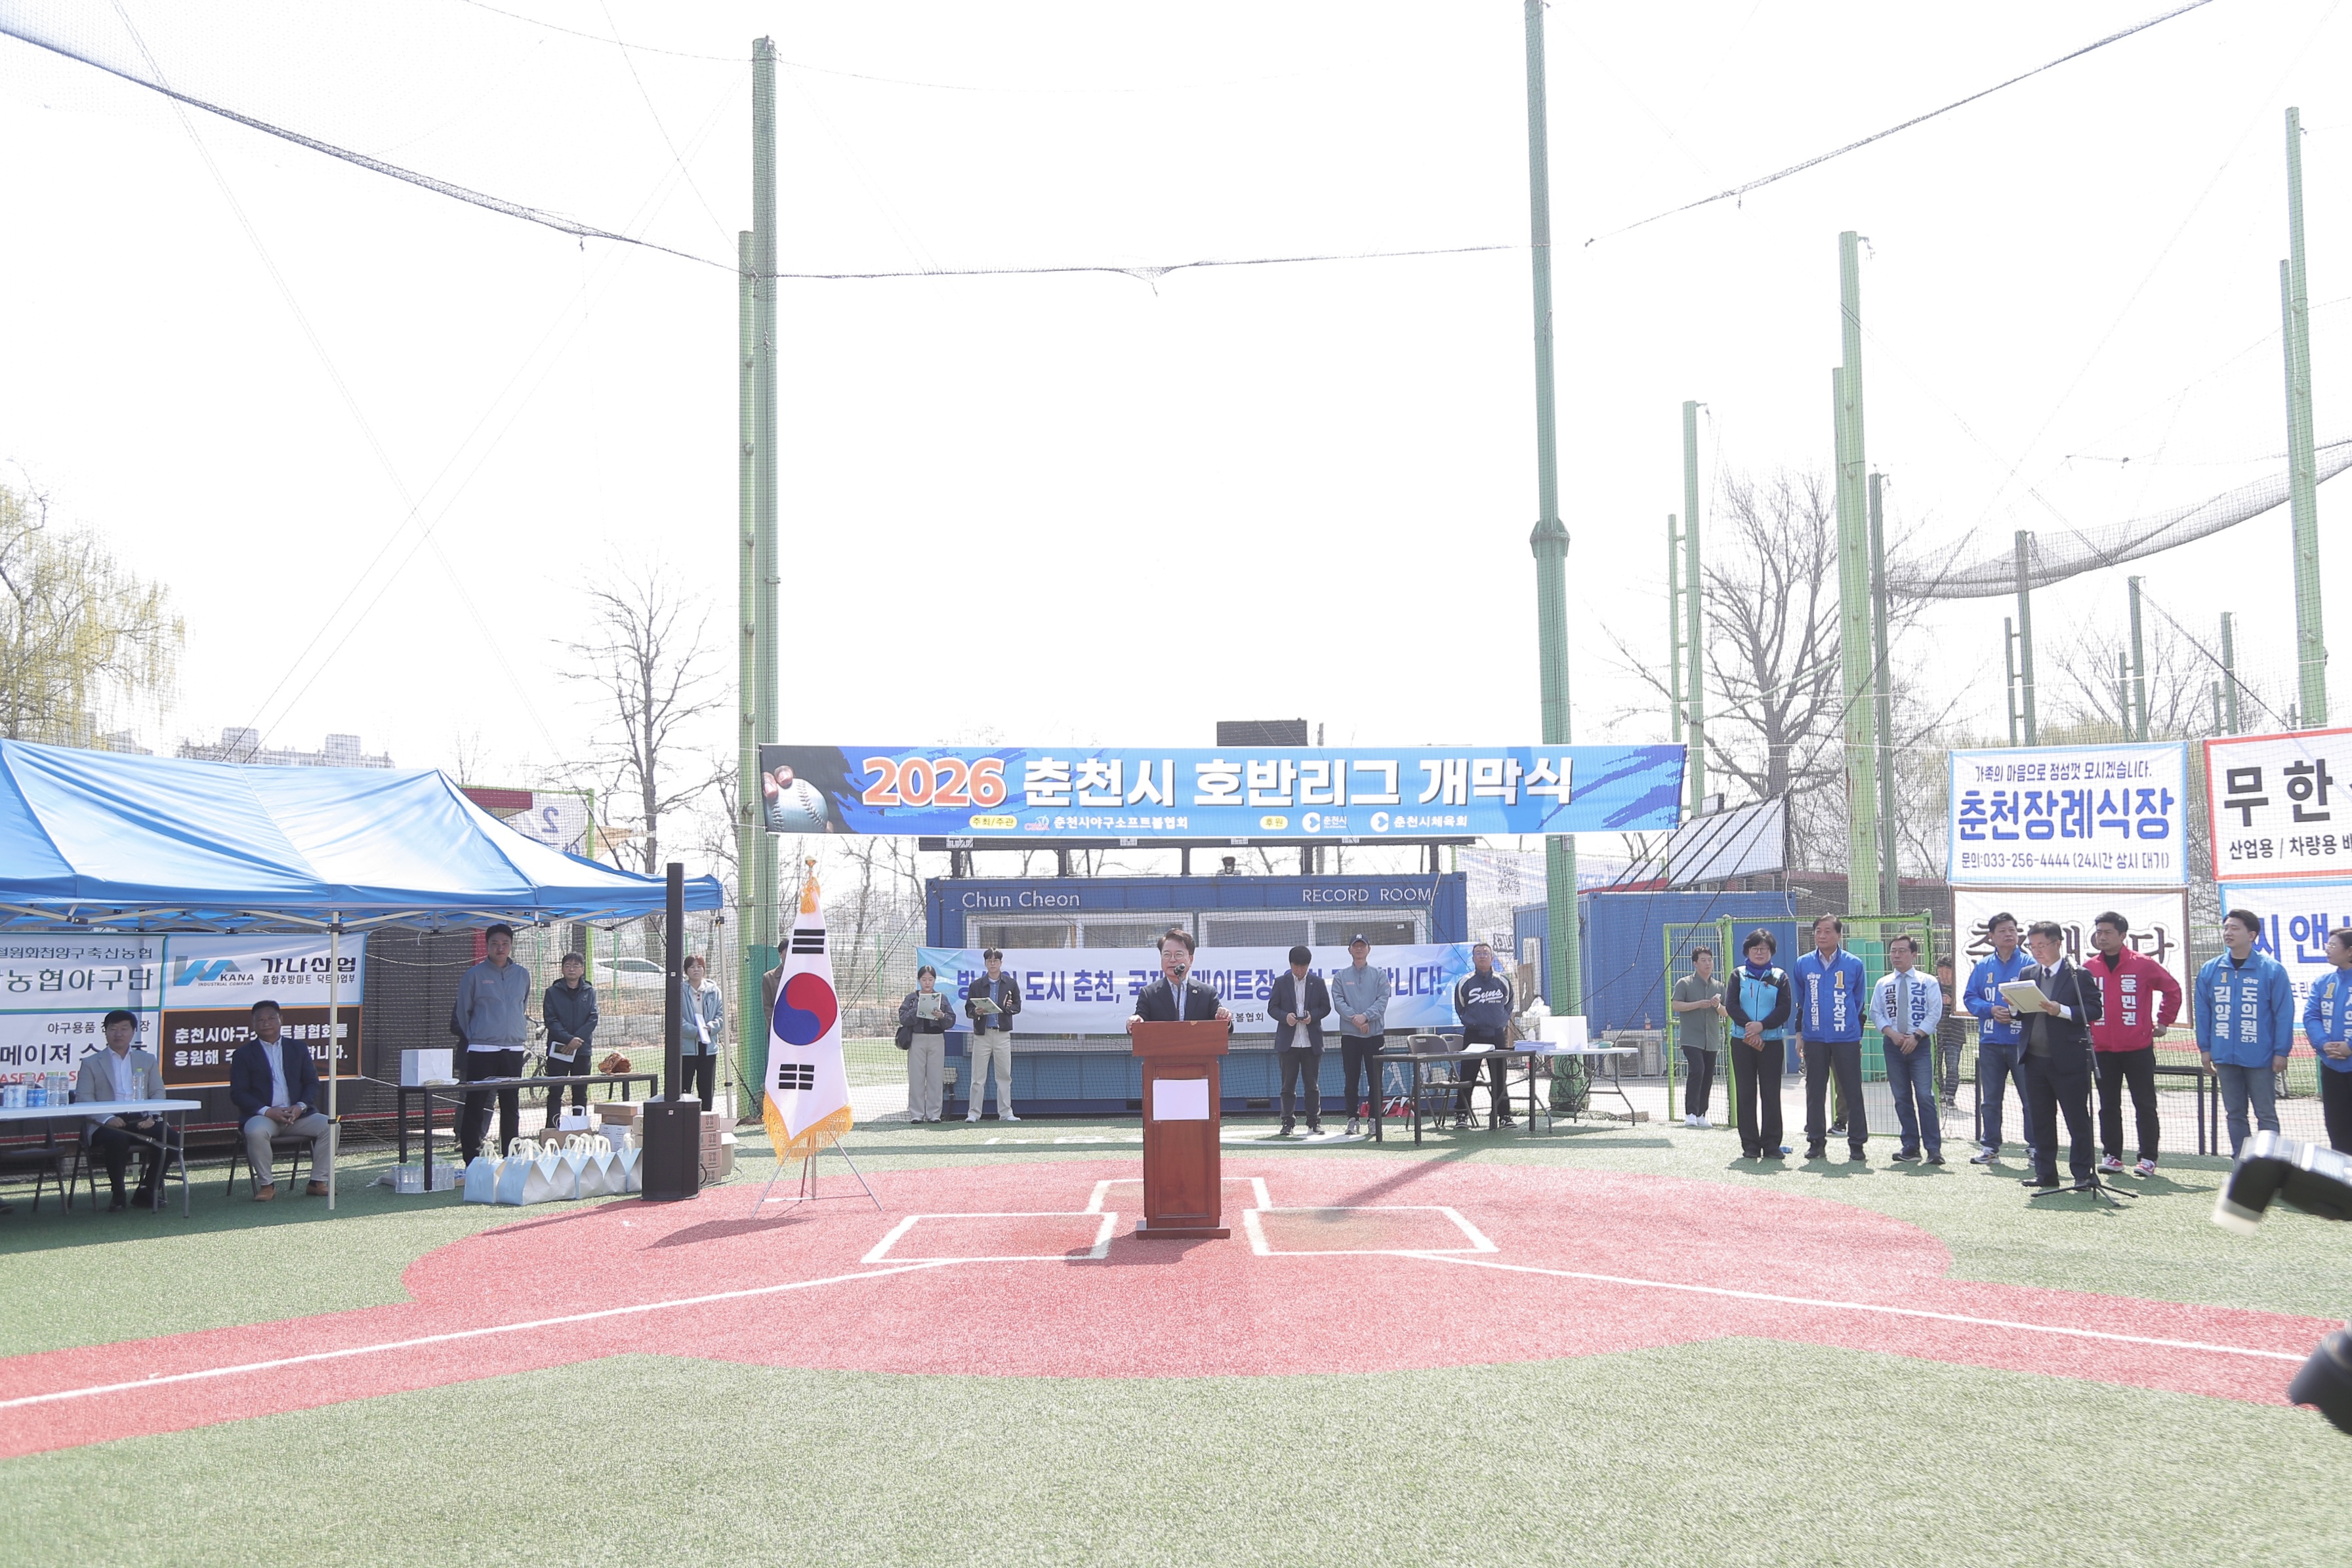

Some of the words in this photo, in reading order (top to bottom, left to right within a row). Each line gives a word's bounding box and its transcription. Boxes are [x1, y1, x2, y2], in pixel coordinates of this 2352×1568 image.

[1975, 766, 2004, 782] 가족의
[2007, 764, 2046, 781] 마음으로
[2050, 762, 2080, 781] 정성껏
[2084, 760, 2152, 780] 모시겠습니다.
[862, 756, 1007, 808] 2026
[1023, 758, 1176, 807] 춘천시
[1194, 758, 1401, 807] 호반리그
[1418, 756, 1573, 806] 개막식
[2224, 758, 2352, 827] 무한
[972, 817, 1014, 827] 주최/주관
[1054, 815, 1189, 829] 춘천시야구소프트볼협회
[1266, 817, 1284, 827] 후원
[1323, 815, 1347, 825] 춘천시
[1393, 815, 1468, 828] 춘천시체육회
[1958, 787, 2174, 840] 춘천장례식장
[2229, 838, 2273, 859] 산업용
[2290, 835, 2337, 856] 차량용
[1962, 853, 2070, 869] 문의:033-256-4444
[2073, 853, 2113, 869] (24시간
[2116, 853, 2139, 869] 상시
[2142, 852, 2169, 868] 대기)
[961, 892, 1011, 909] Chun
[1018, 890, 1081, 908] Cheon
[1302, 888, 1370, 903] RECORD
[1380, 887, 1432, 902] ROOM
[260, 957, 356, 973] 가나산업
[0, 968, 154, 993] 농협야구단
[262, 975, 312, 985] 종합주방마트
[318, 974, 355, 984] 닥트업부
[1834, 970, 1845, 989] 1
[1987, 972, 1993, 983] 1
[2220, 972, 2227, 983] 1
[1025, 970, 1065, 1002] 도시
[1074, 970, 1121, 1004] 춘천,
[1468, 987, 1504, 1004] Suns
[2323, 982, 2336, 999] 1
[1885, 983, 1897, 1018] 교육감
[1833, 991, 1847, 1031] 남상규
[2214, 986, 2231, 1039] 김양욱
[2240, 987, 2258, 1036] 도의원
[48, 1021, 96, 1034] 야구용품
[175, 1023, 348, 1044] 춘천시야구트볼협회를
[2240, 1035, 2258, 1044] 선거
[1, 1043, 71, 1066] 메이져
[175, 1050, 219, 1067] 응원해
